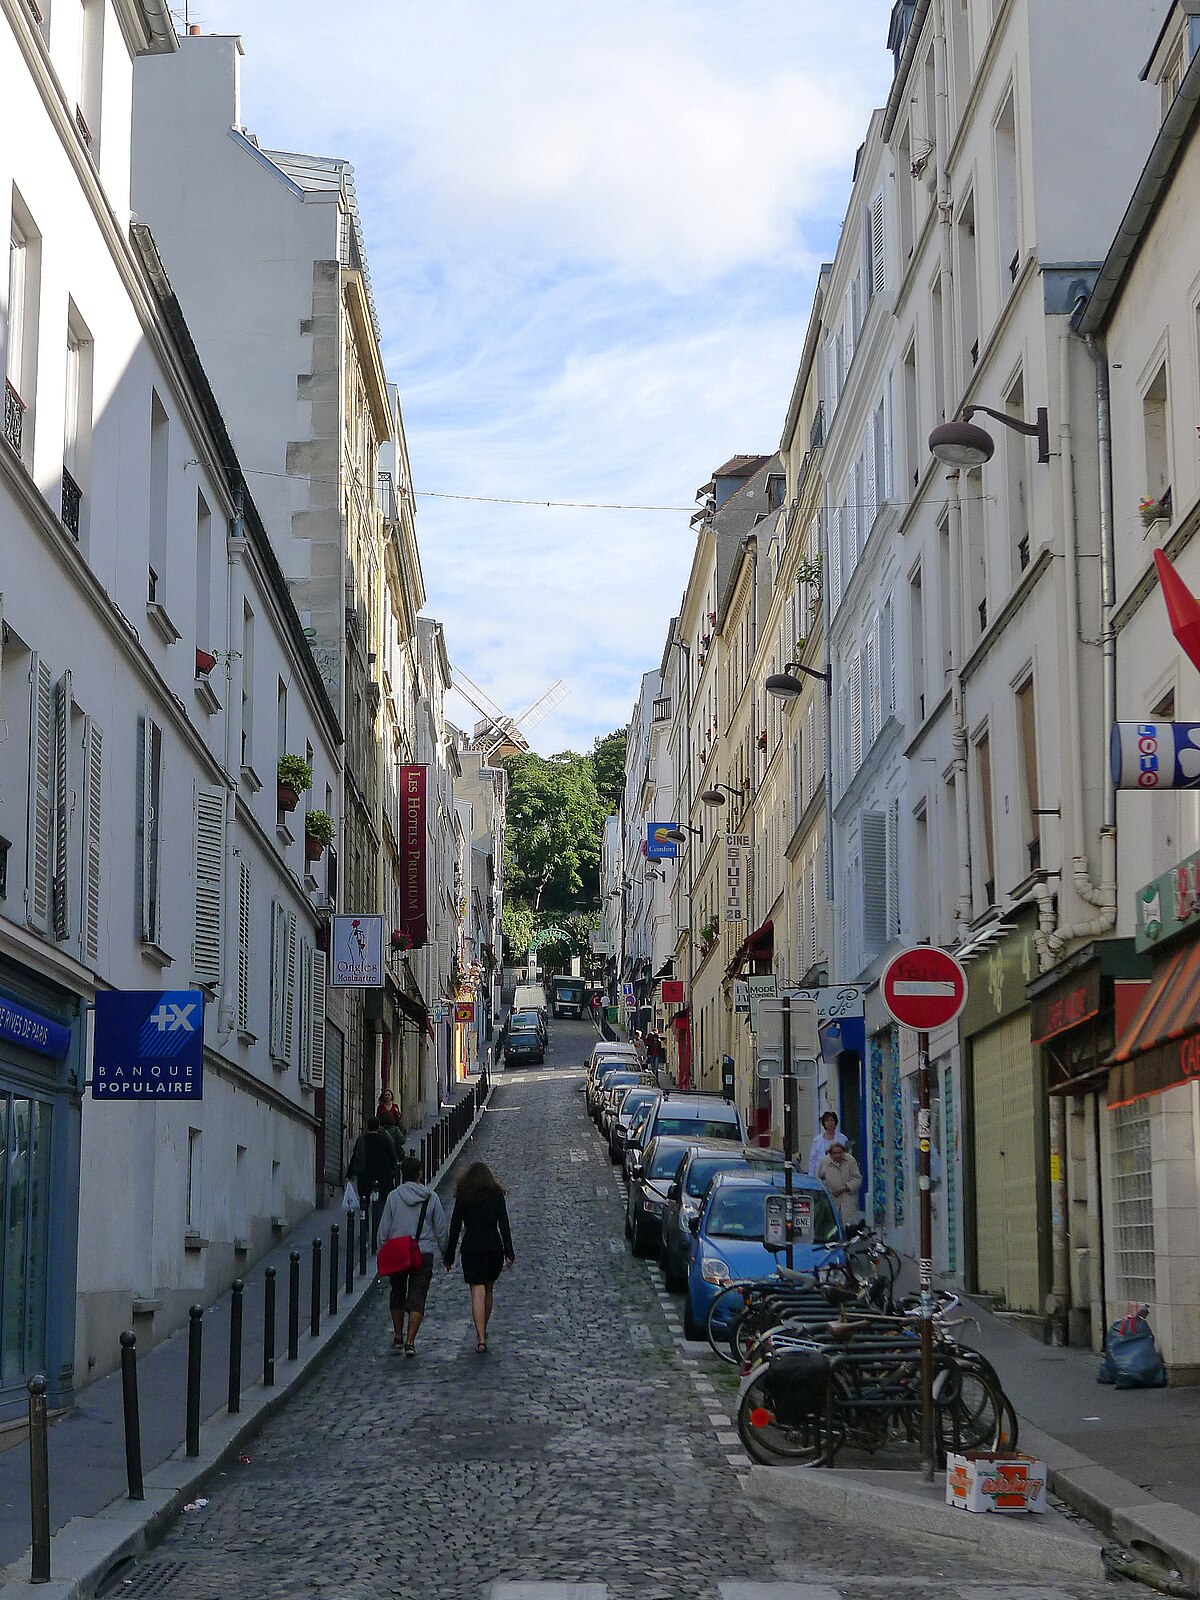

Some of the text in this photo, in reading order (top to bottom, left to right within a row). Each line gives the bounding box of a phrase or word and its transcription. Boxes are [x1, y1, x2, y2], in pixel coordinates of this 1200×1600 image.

[1138, 725, 1158, 787] LOTO
[406, 771, 421, 909] LES HOTELS PREMIUM
[727, 836, 749, 846] CINE
[728, 848, 740, 907] STUDIO
[726, 909, 741, 919] 28
[338, 961, 378, 976] Ongles
[750, 985, 776, 994] MODE
[21, 1018, 32, 1039] DE
[31, 1022, 49, 1046] PARIS
[99, 1066, 193, 1077] BANQUE
[99, 1082, 193, 1093] POPULAIRE
